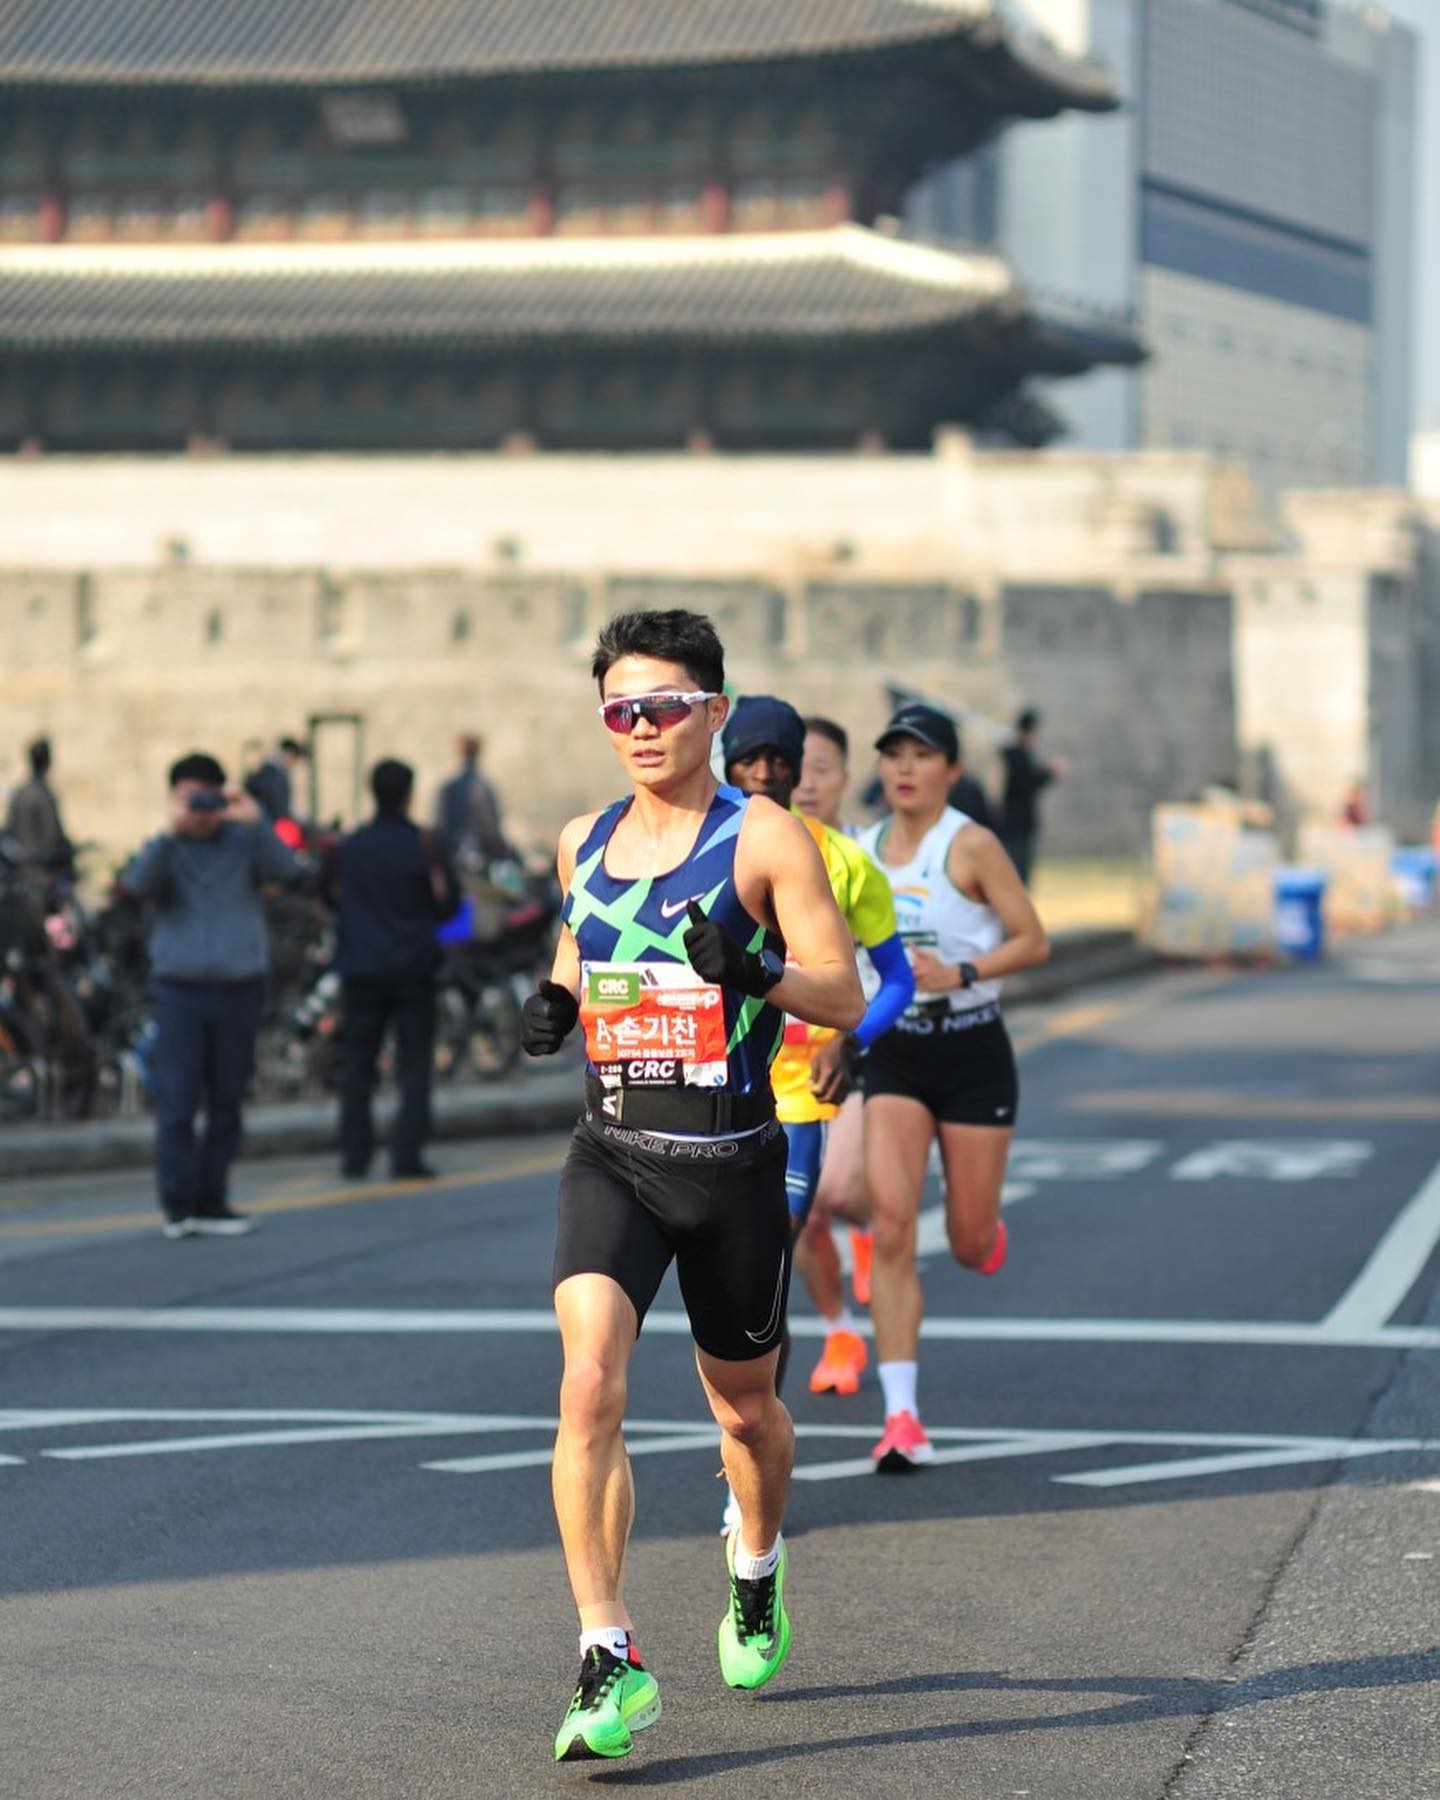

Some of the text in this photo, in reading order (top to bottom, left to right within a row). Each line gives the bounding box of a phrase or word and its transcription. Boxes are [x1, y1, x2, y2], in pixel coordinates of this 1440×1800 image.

[598, 978, 629, 995] CRC
[613, 1014, 698, 1046] 손기찬
[627, 1059, 677, 1079] CRC
[604, 1125, 739, 1159] NIKE PRO
